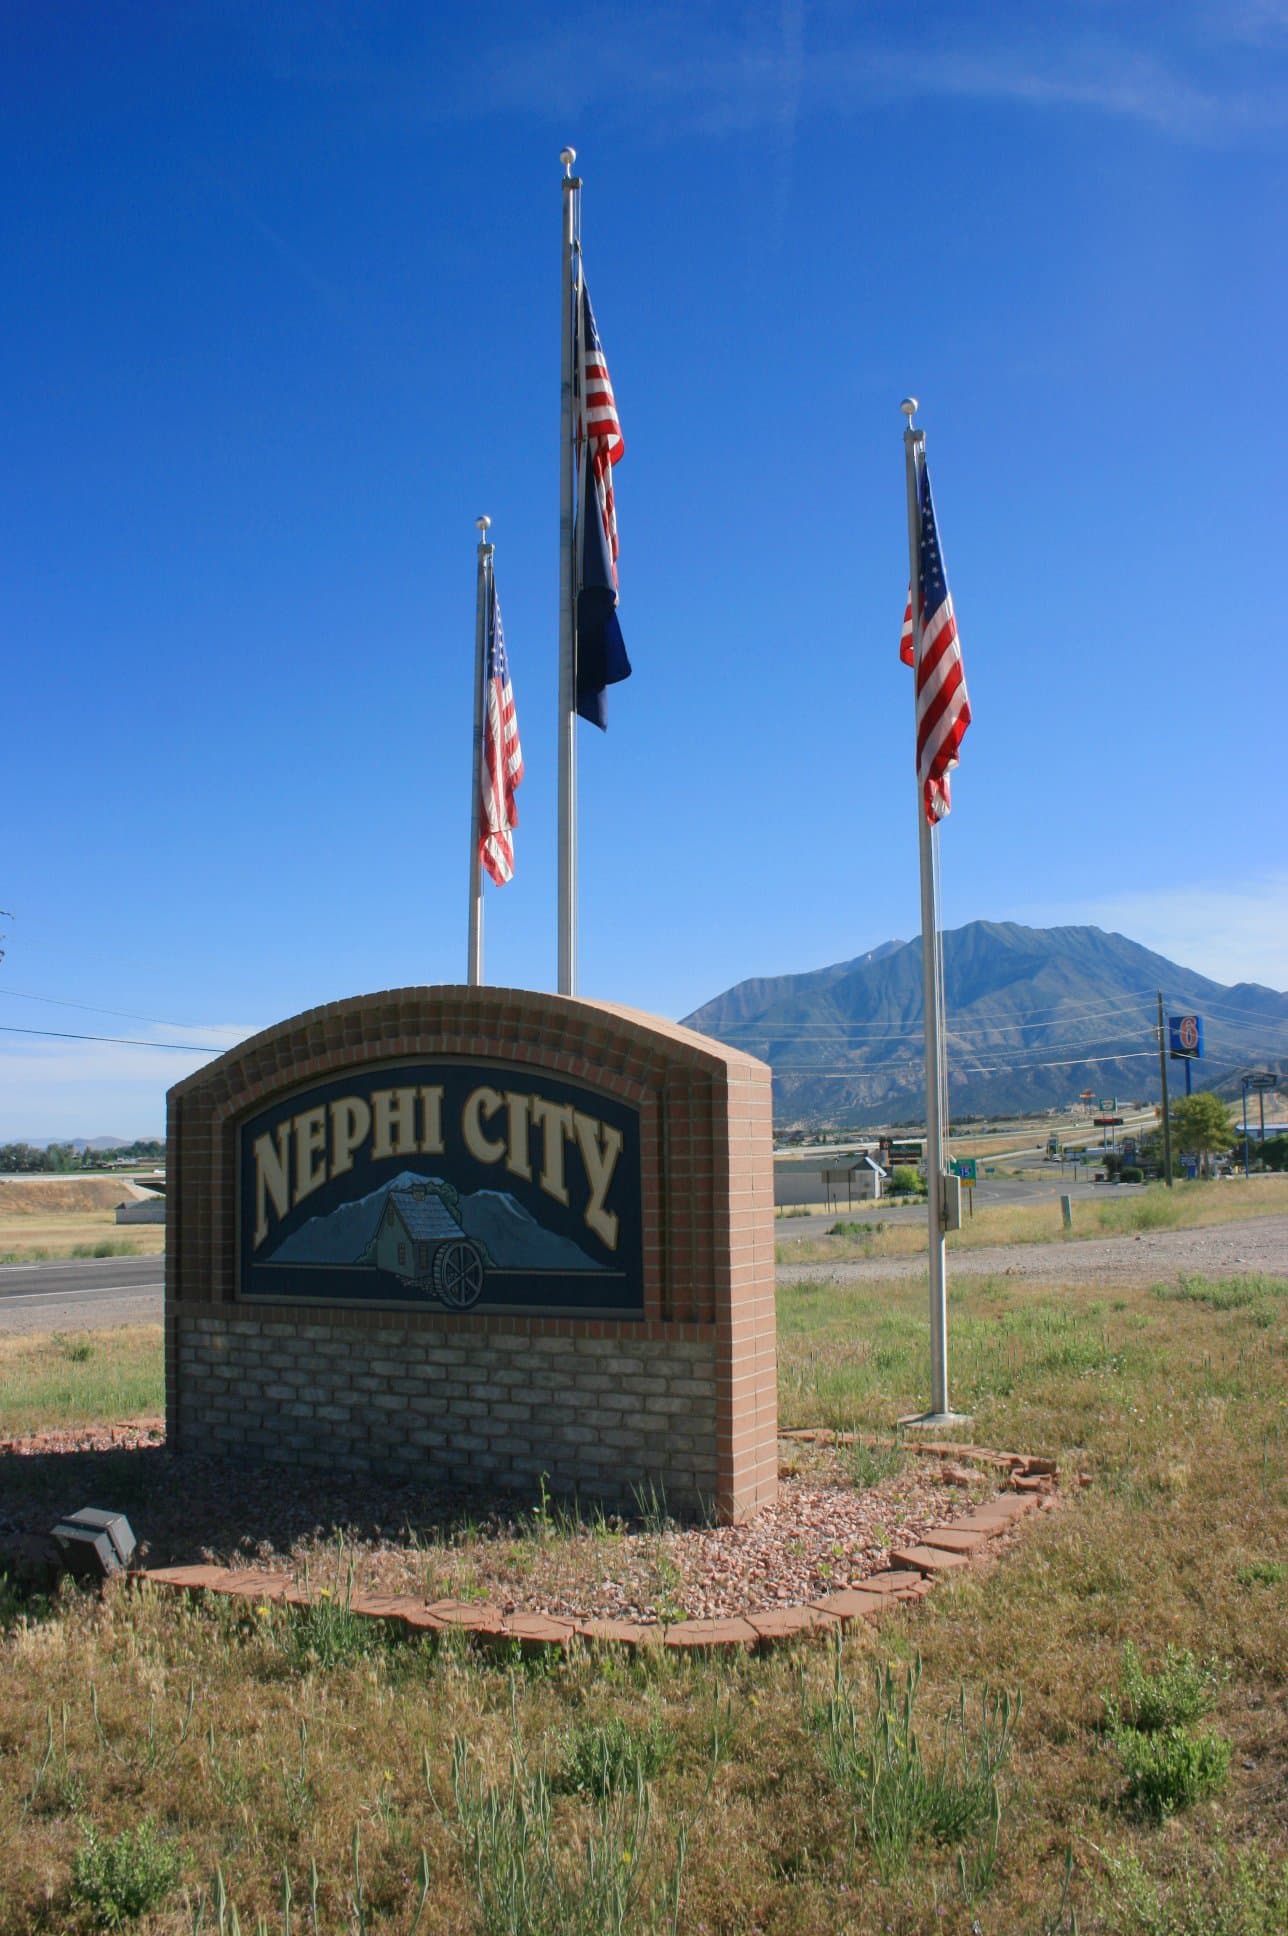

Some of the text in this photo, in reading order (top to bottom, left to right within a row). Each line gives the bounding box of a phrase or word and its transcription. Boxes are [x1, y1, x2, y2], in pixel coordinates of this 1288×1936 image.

[1181, 1016, 1198, 1049] 6
[253, 1085, 623, 1251] NEPHI CITY
[961, 1167, 970, 1177] 15
